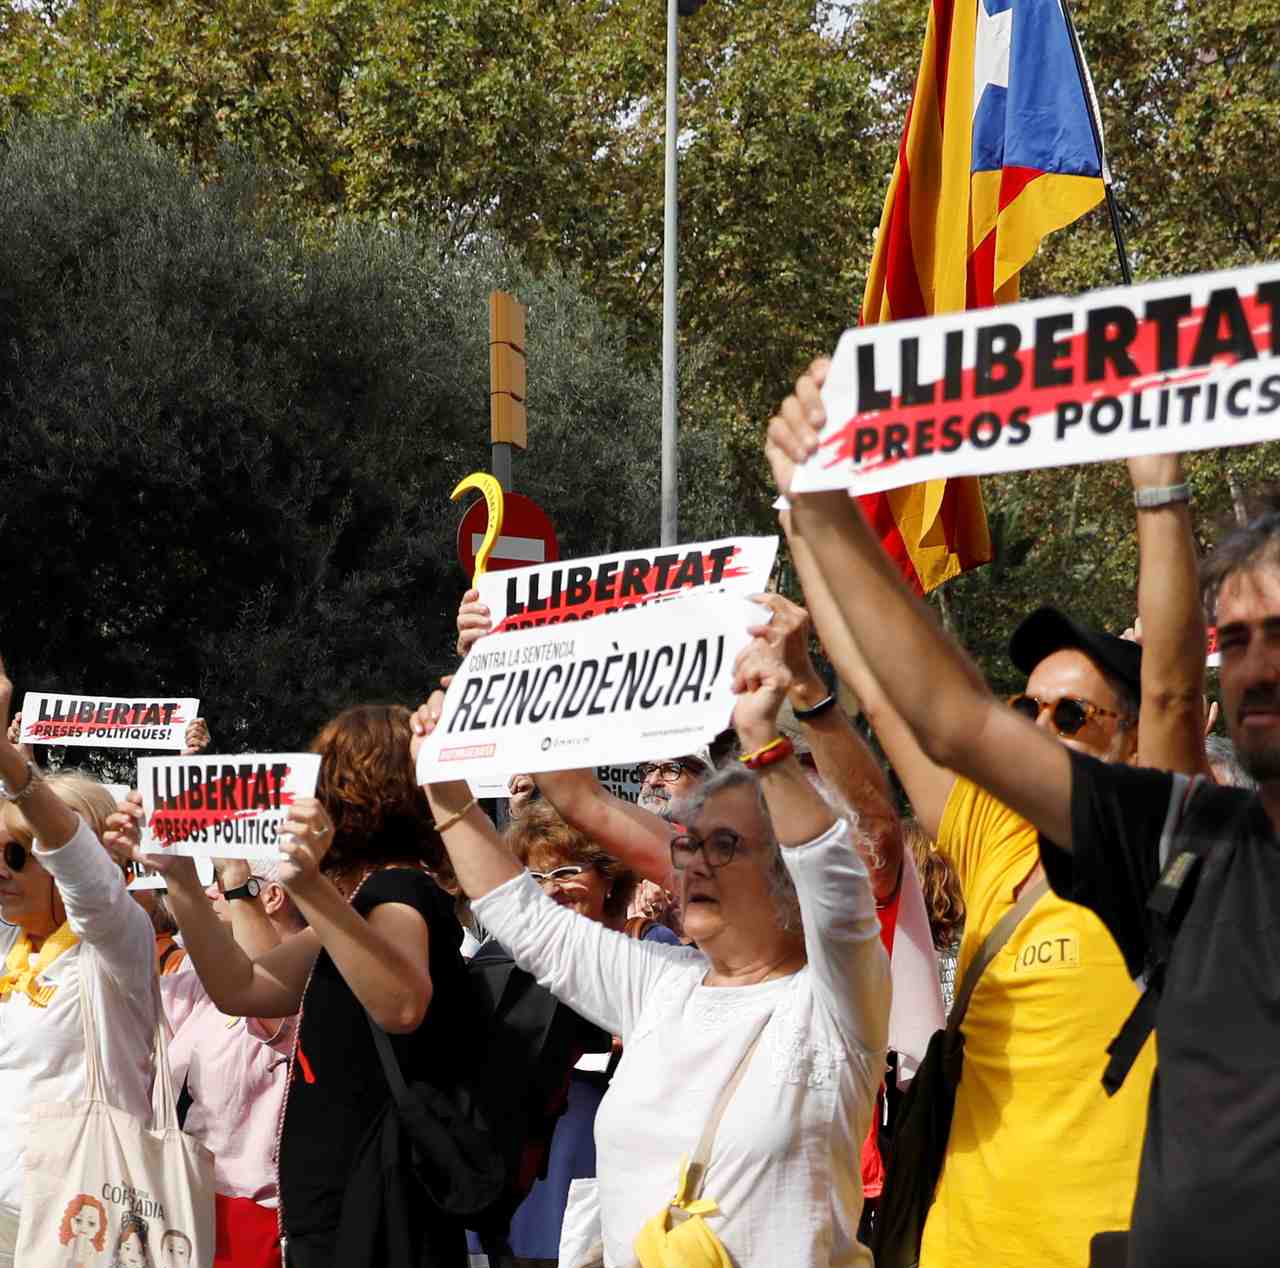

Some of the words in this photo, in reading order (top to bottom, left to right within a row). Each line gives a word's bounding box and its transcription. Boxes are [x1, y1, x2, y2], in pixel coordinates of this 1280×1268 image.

[852, 406, 1032, 465] PRESOS
[506, 544, 736, 617] LLIBERTAT
[447, 635, 726, 734] REINCIDÈNCIA!
[34, 724, 84, 738] PRESES
[38, 698, 178, 726] LLIBERTAT
[152, 763, 288, 812] LLIBERTAT
[153, 817, 209, 846] PRESOS
[1023, 938, 1074, 967] OCT.
